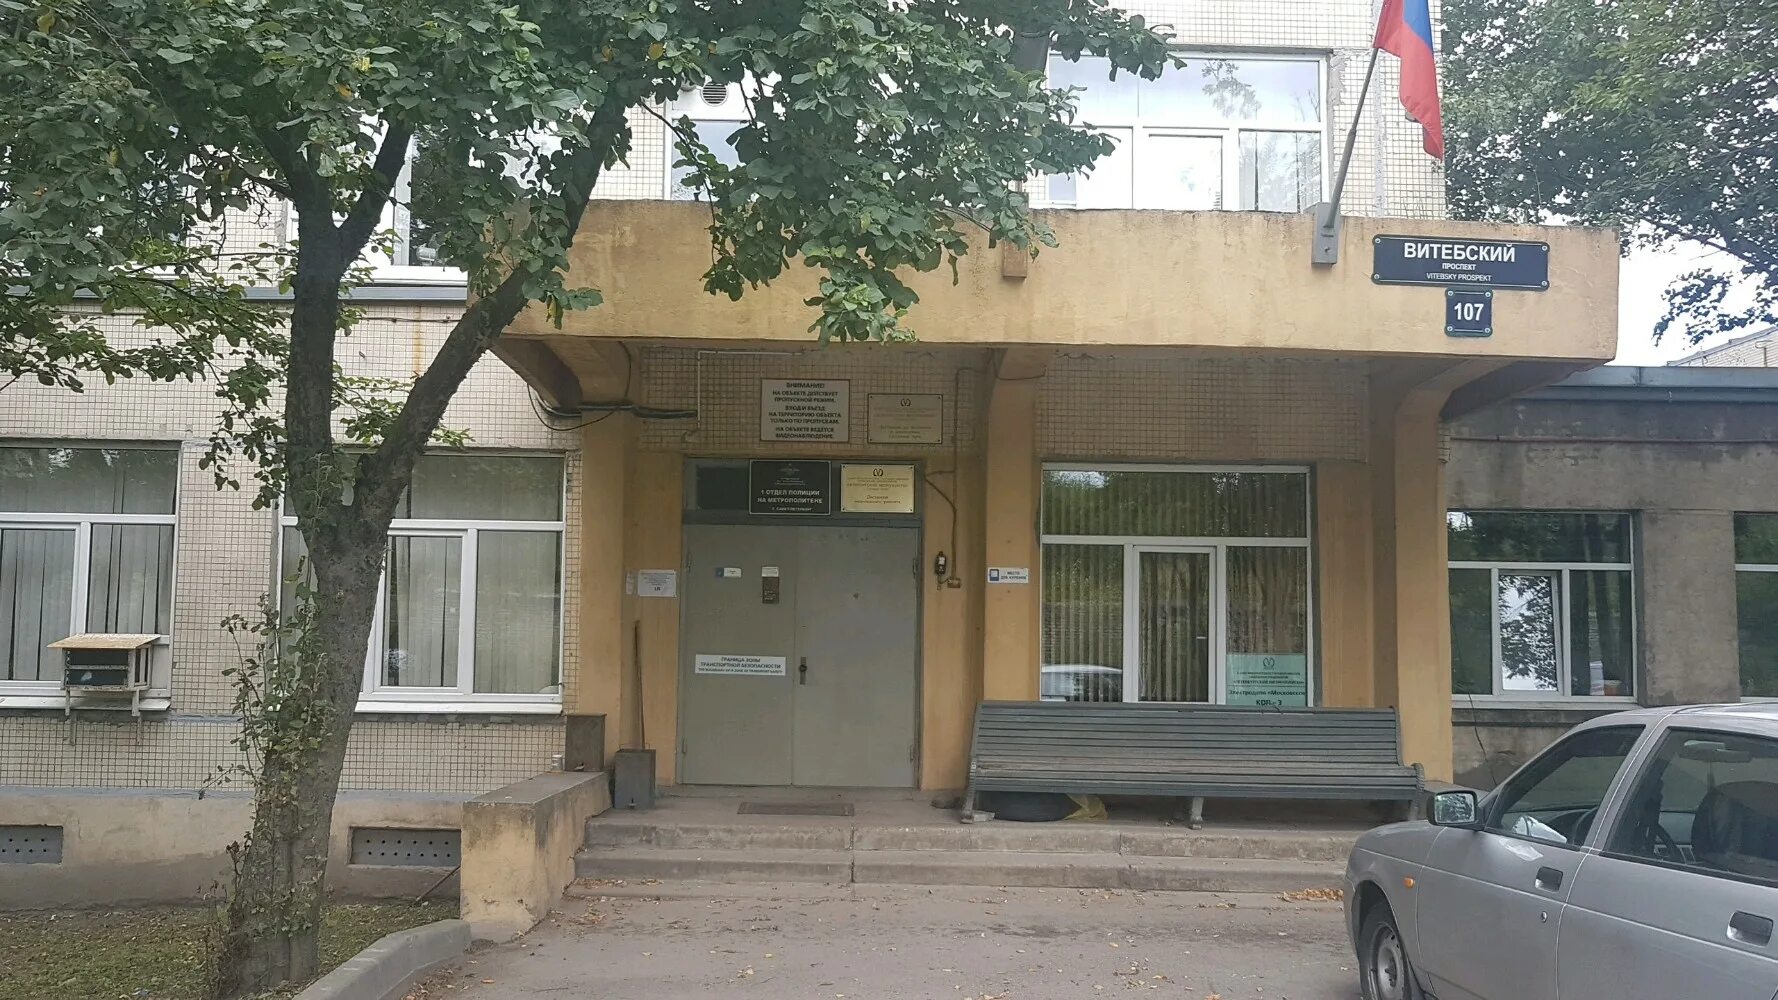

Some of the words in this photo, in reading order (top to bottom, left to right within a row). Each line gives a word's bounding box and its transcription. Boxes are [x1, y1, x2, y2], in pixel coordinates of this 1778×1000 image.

[1403, 242, 1516, 263] ВИТЕБСКИЙ
[1441, 263, 1476, 271] ПРОСПЕКТ
[1426, 272, 1457, 281] VITEBSKY
[1458, 273, 1493, 282] PROSPEKT
[1453, 302, 1485, 321] 107
